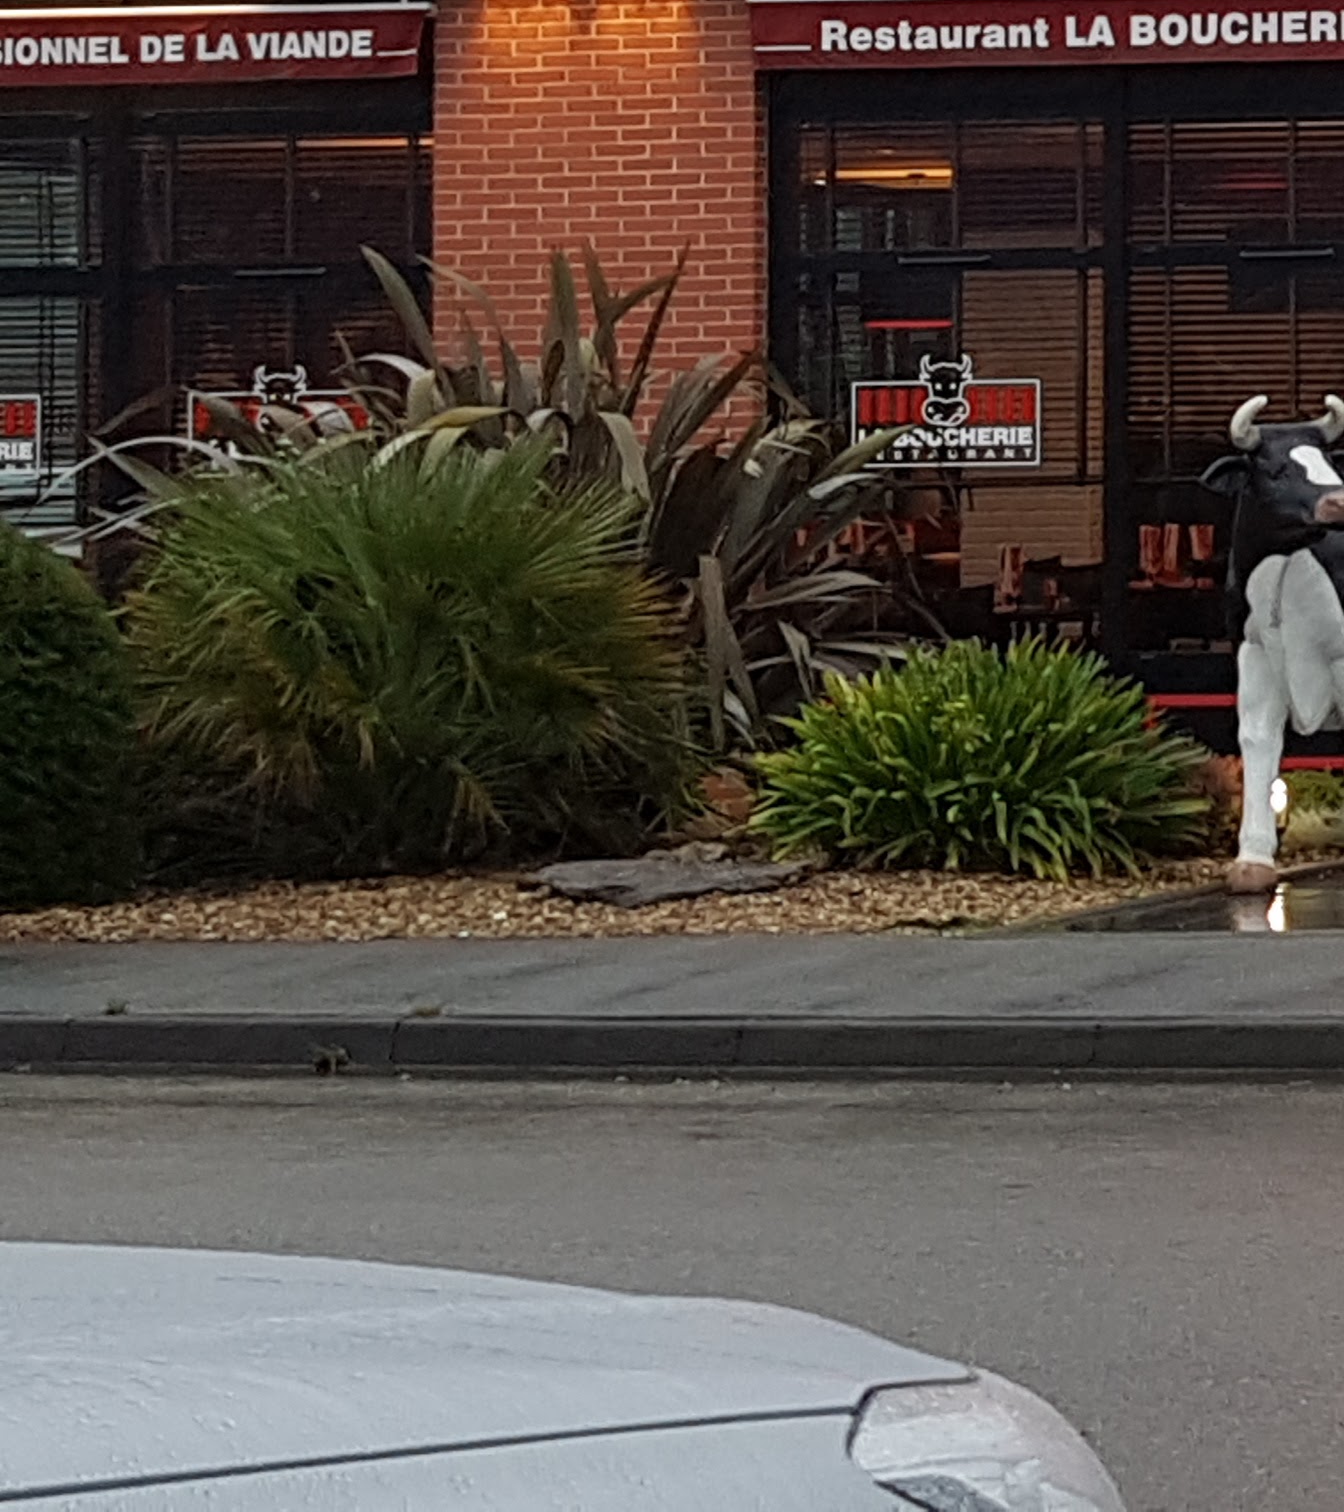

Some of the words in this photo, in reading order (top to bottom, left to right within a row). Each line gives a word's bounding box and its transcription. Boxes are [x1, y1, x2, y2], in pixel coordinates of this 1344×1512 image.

[0, 36, 129, 65] IONNEL
[140, 34, 185, 62] DE
[199, 33, 239, 61] LA
[247, 30, 374, 59] VIANDE
[821, 18, 1050, 51] Restaurant
[1065, 15, 1115, 47] LA
